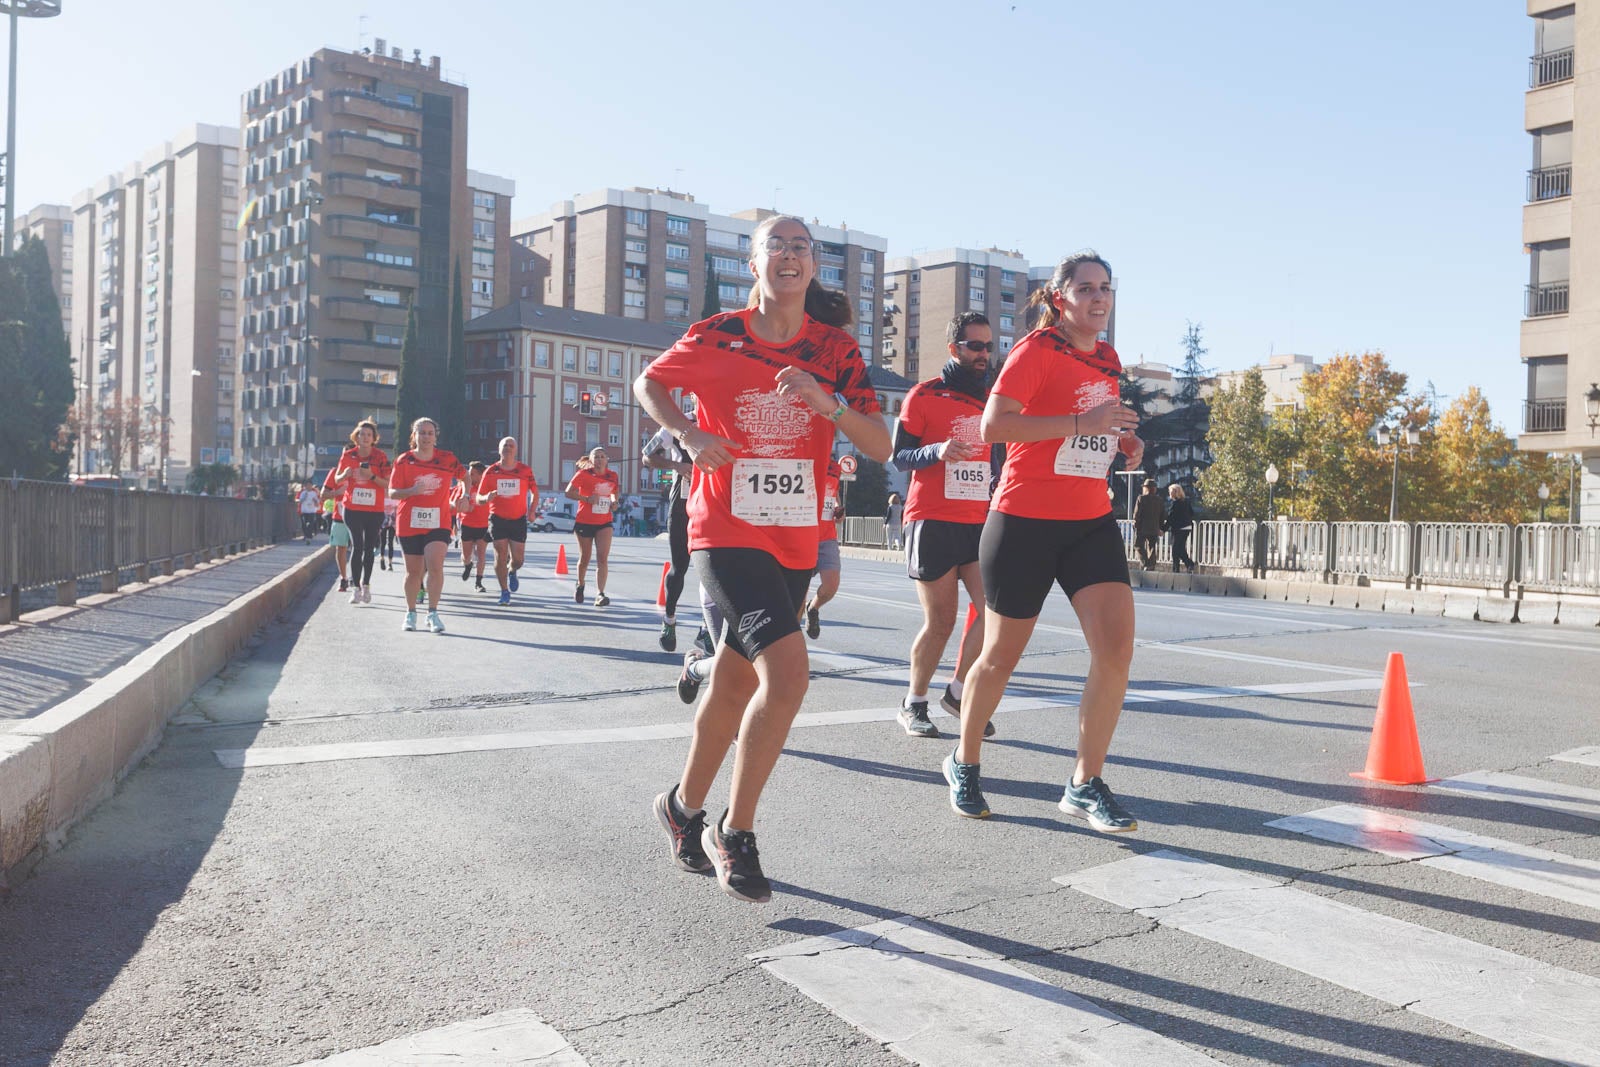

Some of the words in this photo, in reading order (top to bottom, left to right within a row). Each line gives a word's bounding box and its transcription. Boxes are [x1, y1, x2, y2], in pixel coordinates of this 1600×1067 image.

[737, 406, 809, 423] carrera
[748, 474, 805, 494] 1592
[953, 469, 984, 482] 1055
